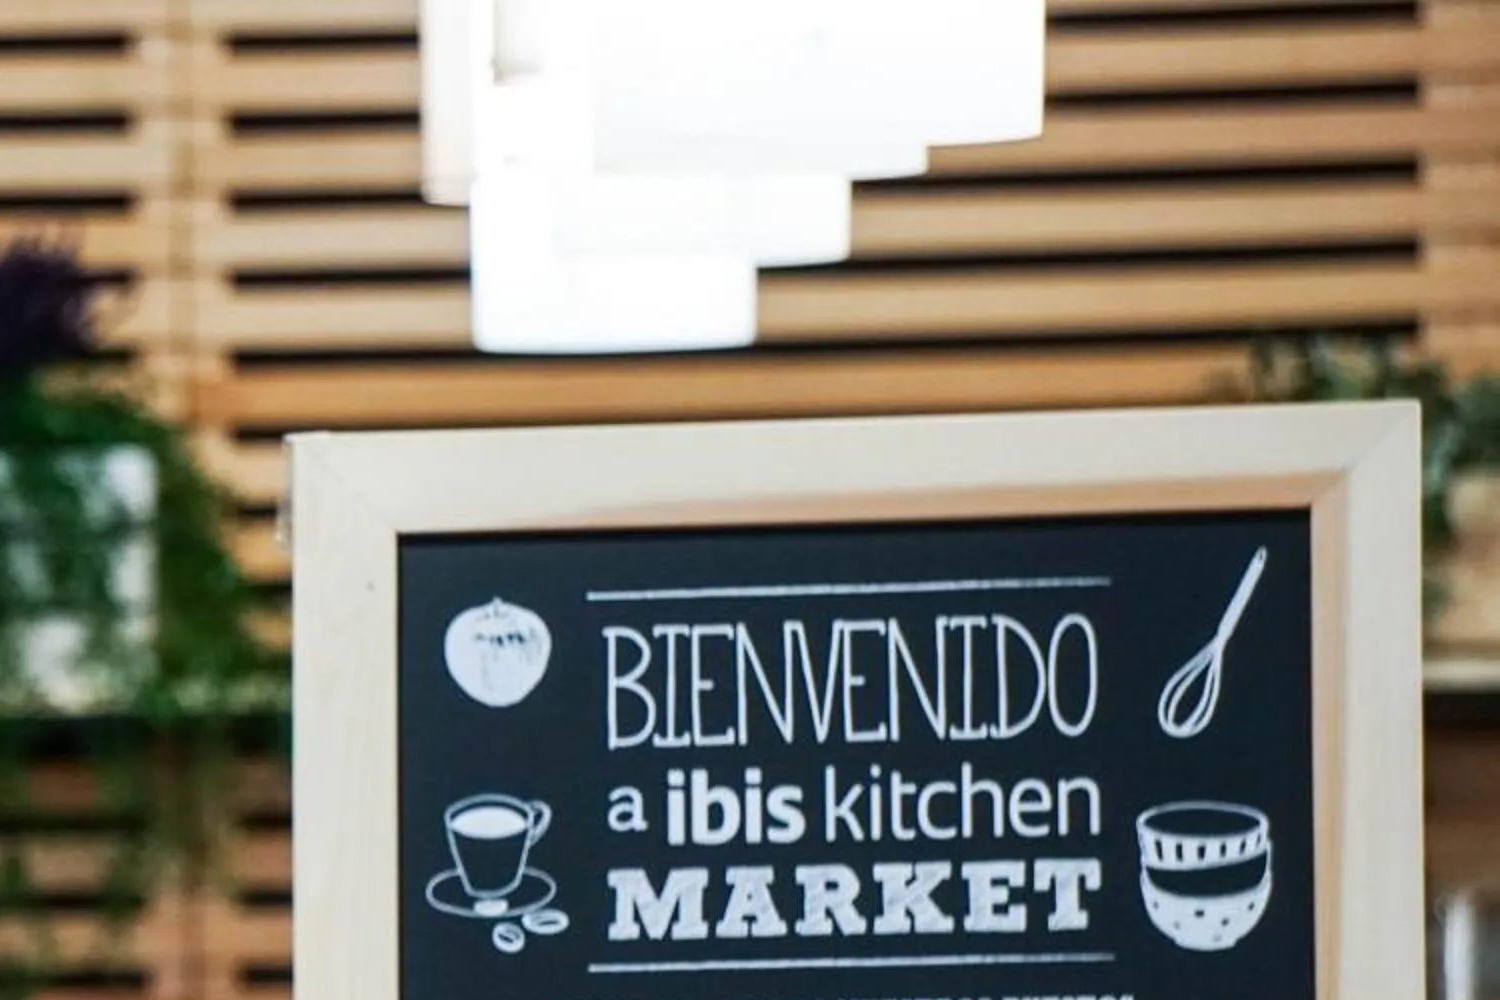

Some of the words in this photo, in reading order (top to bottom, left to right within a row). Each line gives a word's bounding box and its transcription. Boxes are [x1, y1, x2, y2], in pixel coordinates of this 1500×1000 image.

[601, 613, 1098, 751] BIENVENIDO
[607, 785, 649, 832] a
[667, 766, 807, 846] ibis
[824, 761, 1101, 843] kitchen
[606, 857, 1102, 941] MARKET
